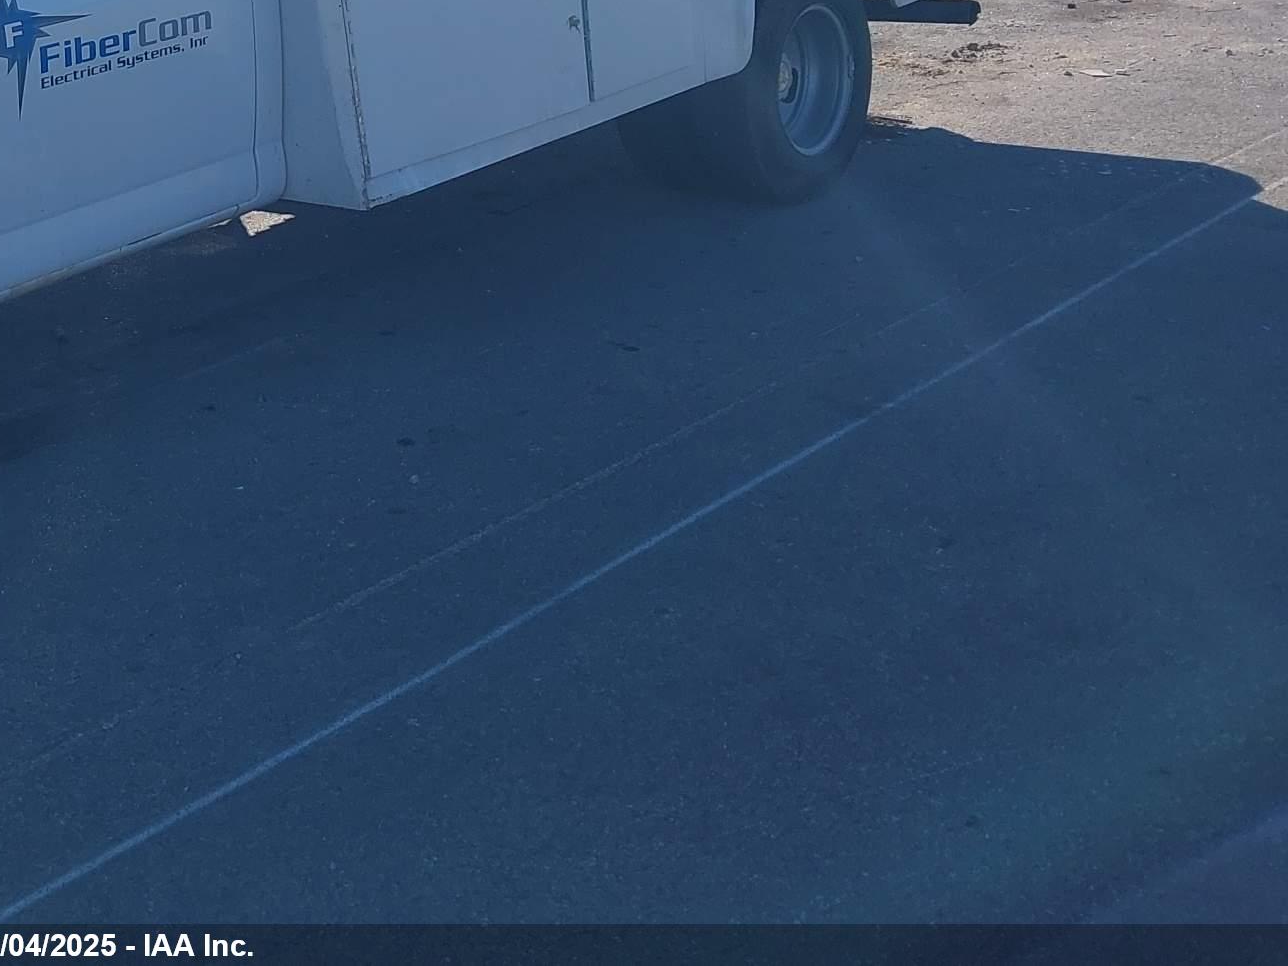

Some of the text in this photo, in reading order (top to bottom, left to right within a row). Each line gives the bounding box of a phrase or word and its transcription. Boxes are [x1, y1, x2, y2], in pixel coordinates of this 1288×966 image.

[3, 21, 25, 49] F
[39, 10, 212, 74] FiberCom
[40, 60, 112, 89] Electrical
